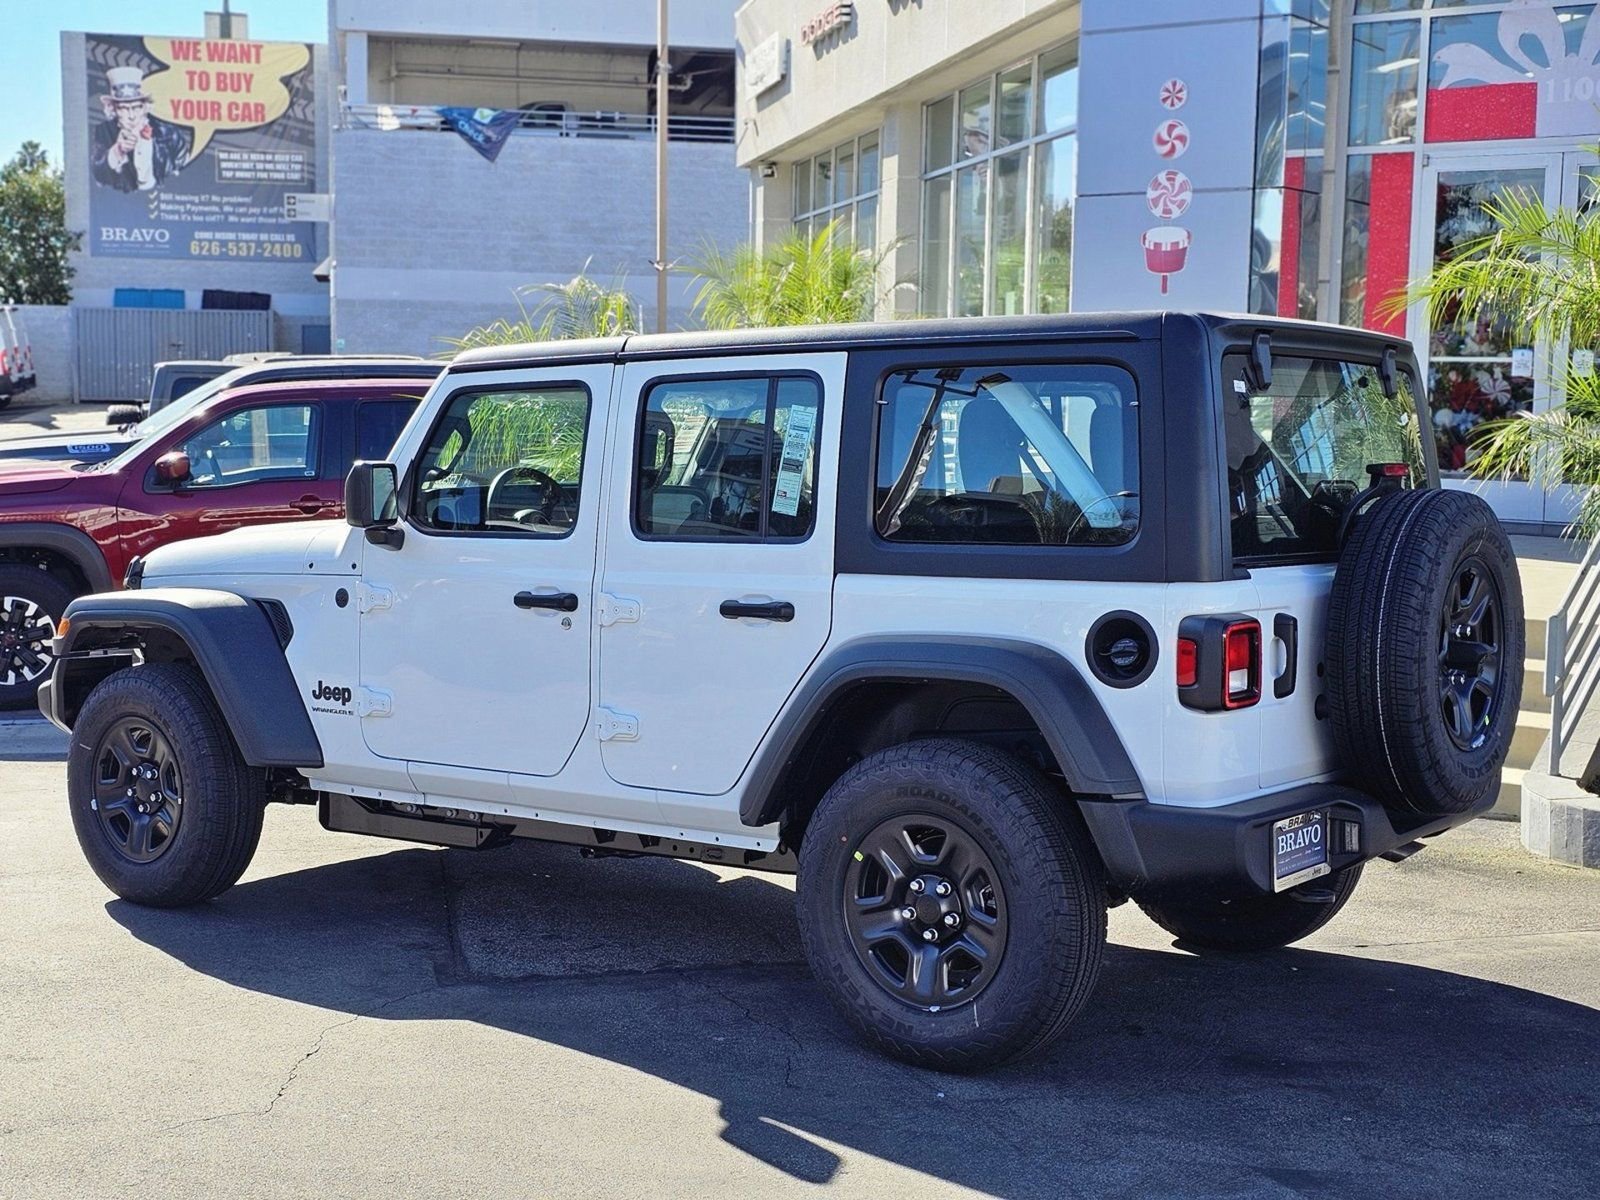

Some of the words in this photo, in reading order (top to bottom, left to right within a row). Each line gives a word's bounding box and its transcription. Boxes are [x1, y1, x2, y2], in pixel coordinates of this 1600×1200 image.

[801, 3, 851, 46] DODGE
[170, 40, 202, 61] WE
[206, 41, 264, 64] WANT
[185, 70, 210, 92] TO
[216, 71, 254, 93] BUY
[1541, 77, 1600, 102] 110
[170, 99, 222, 121] YOUR
[227, 100, 266, 123] CAR
[100, 226, 170, 242] BRAVO
[190, 240, 302, 258] 626-537-2400
[312, 680, 352, 706] Jeep
[312, 706, 348, 716] WRANGLER
[1287, 811, 1316, 829] BRAVO
[1277, 824, 1322, 855] BRAVO
[832, 961, 915, 1037] NEXEN
